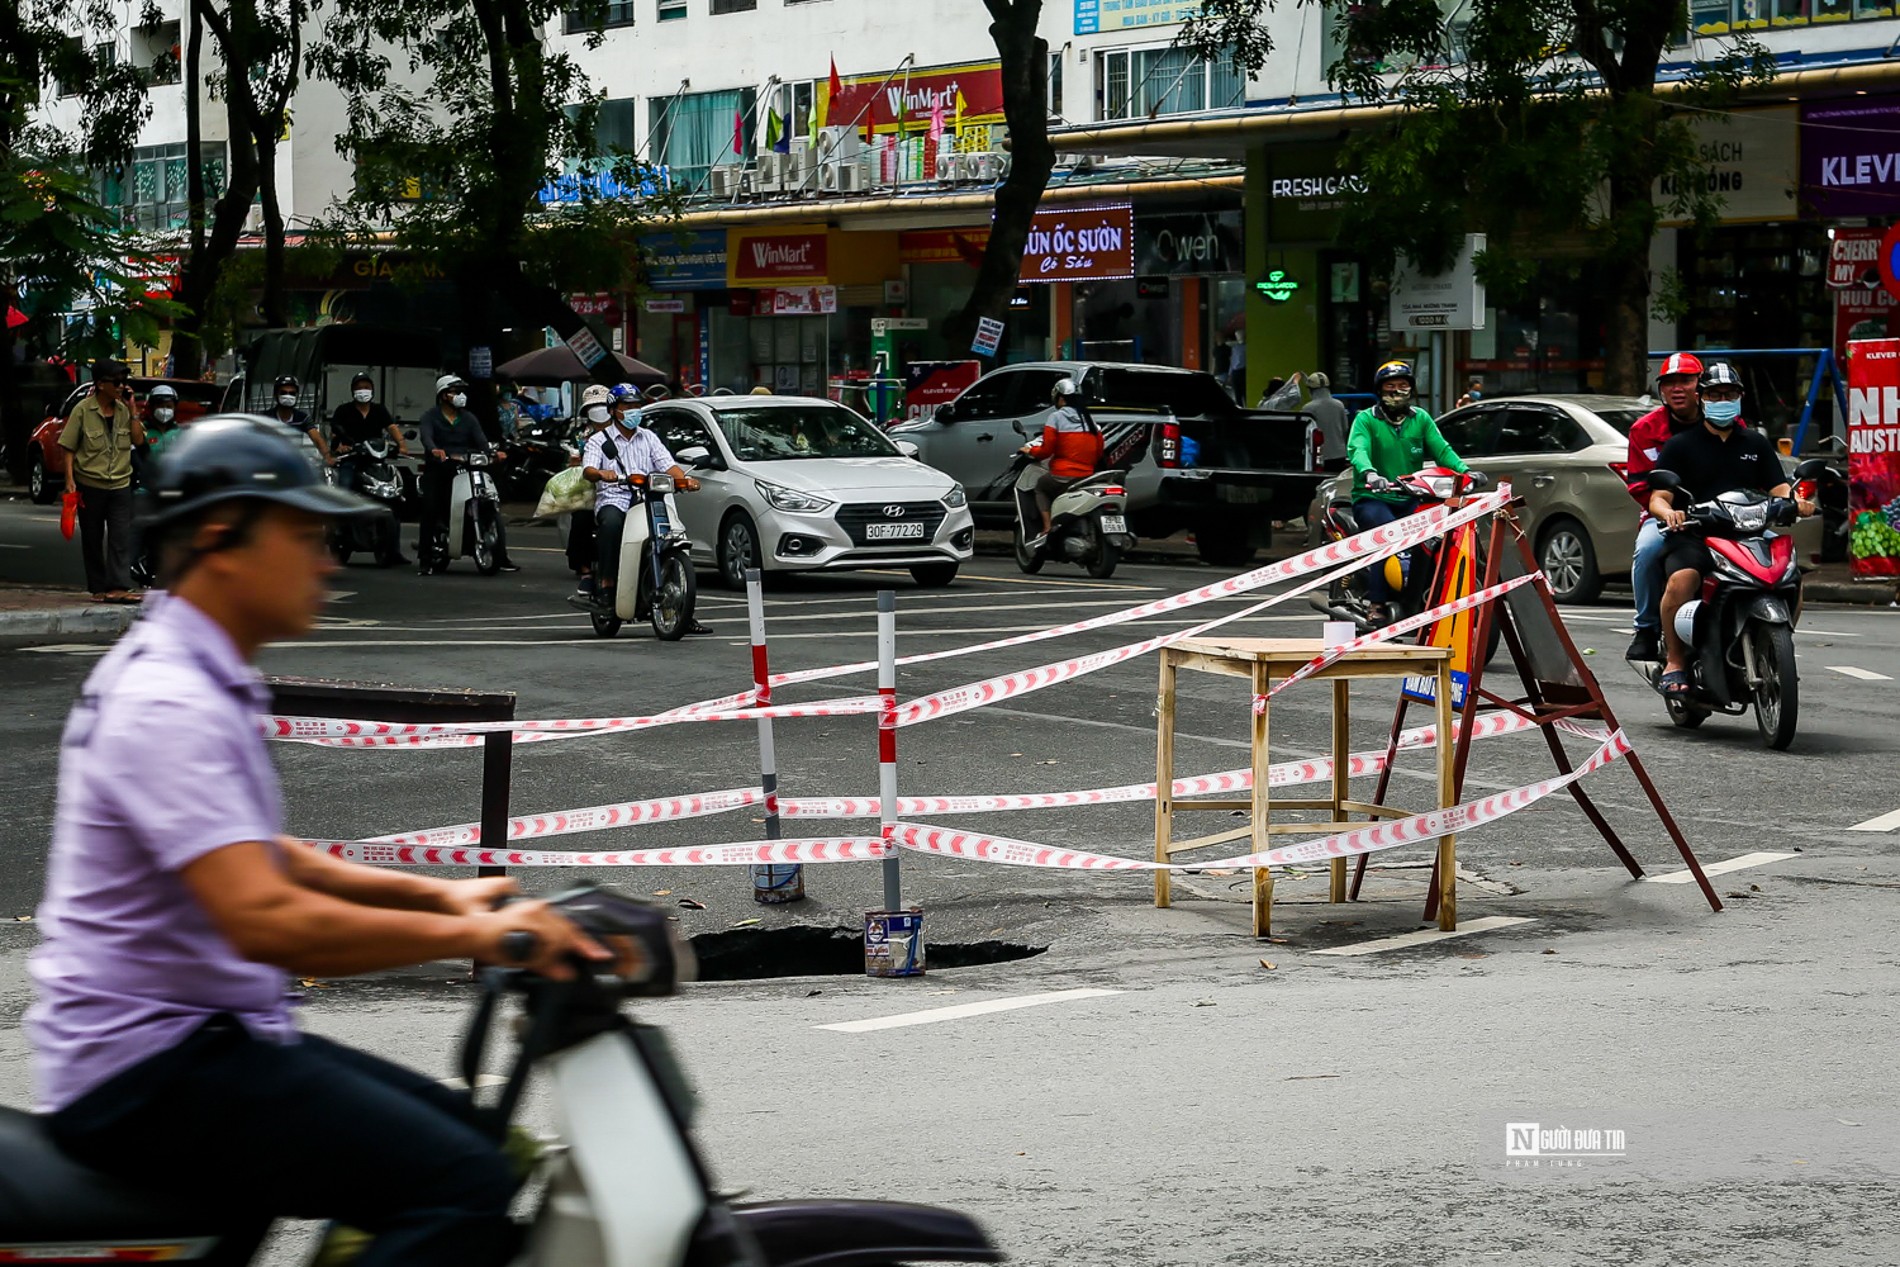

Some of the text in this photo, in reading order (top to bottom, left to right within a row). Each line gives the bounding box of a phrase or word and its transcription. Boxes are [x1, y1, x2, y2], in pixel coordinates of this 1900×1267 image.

[1700, 140, 1743, 162] SÁCH
[1272, 177, 1322, 198] FRESH
[1023, 225, 1050, 256] ÚN
[1078, 219, 1122, 253] SƯỜN
[1157, 229, 1219, 262] Owen
[1832, 238, 1882, 261] CHERR
[1065, 255, 1093, 269] Sáu
[1866, 352, 1897, 360] KLEVER
[1850, 428, 1900, 453] AUST
